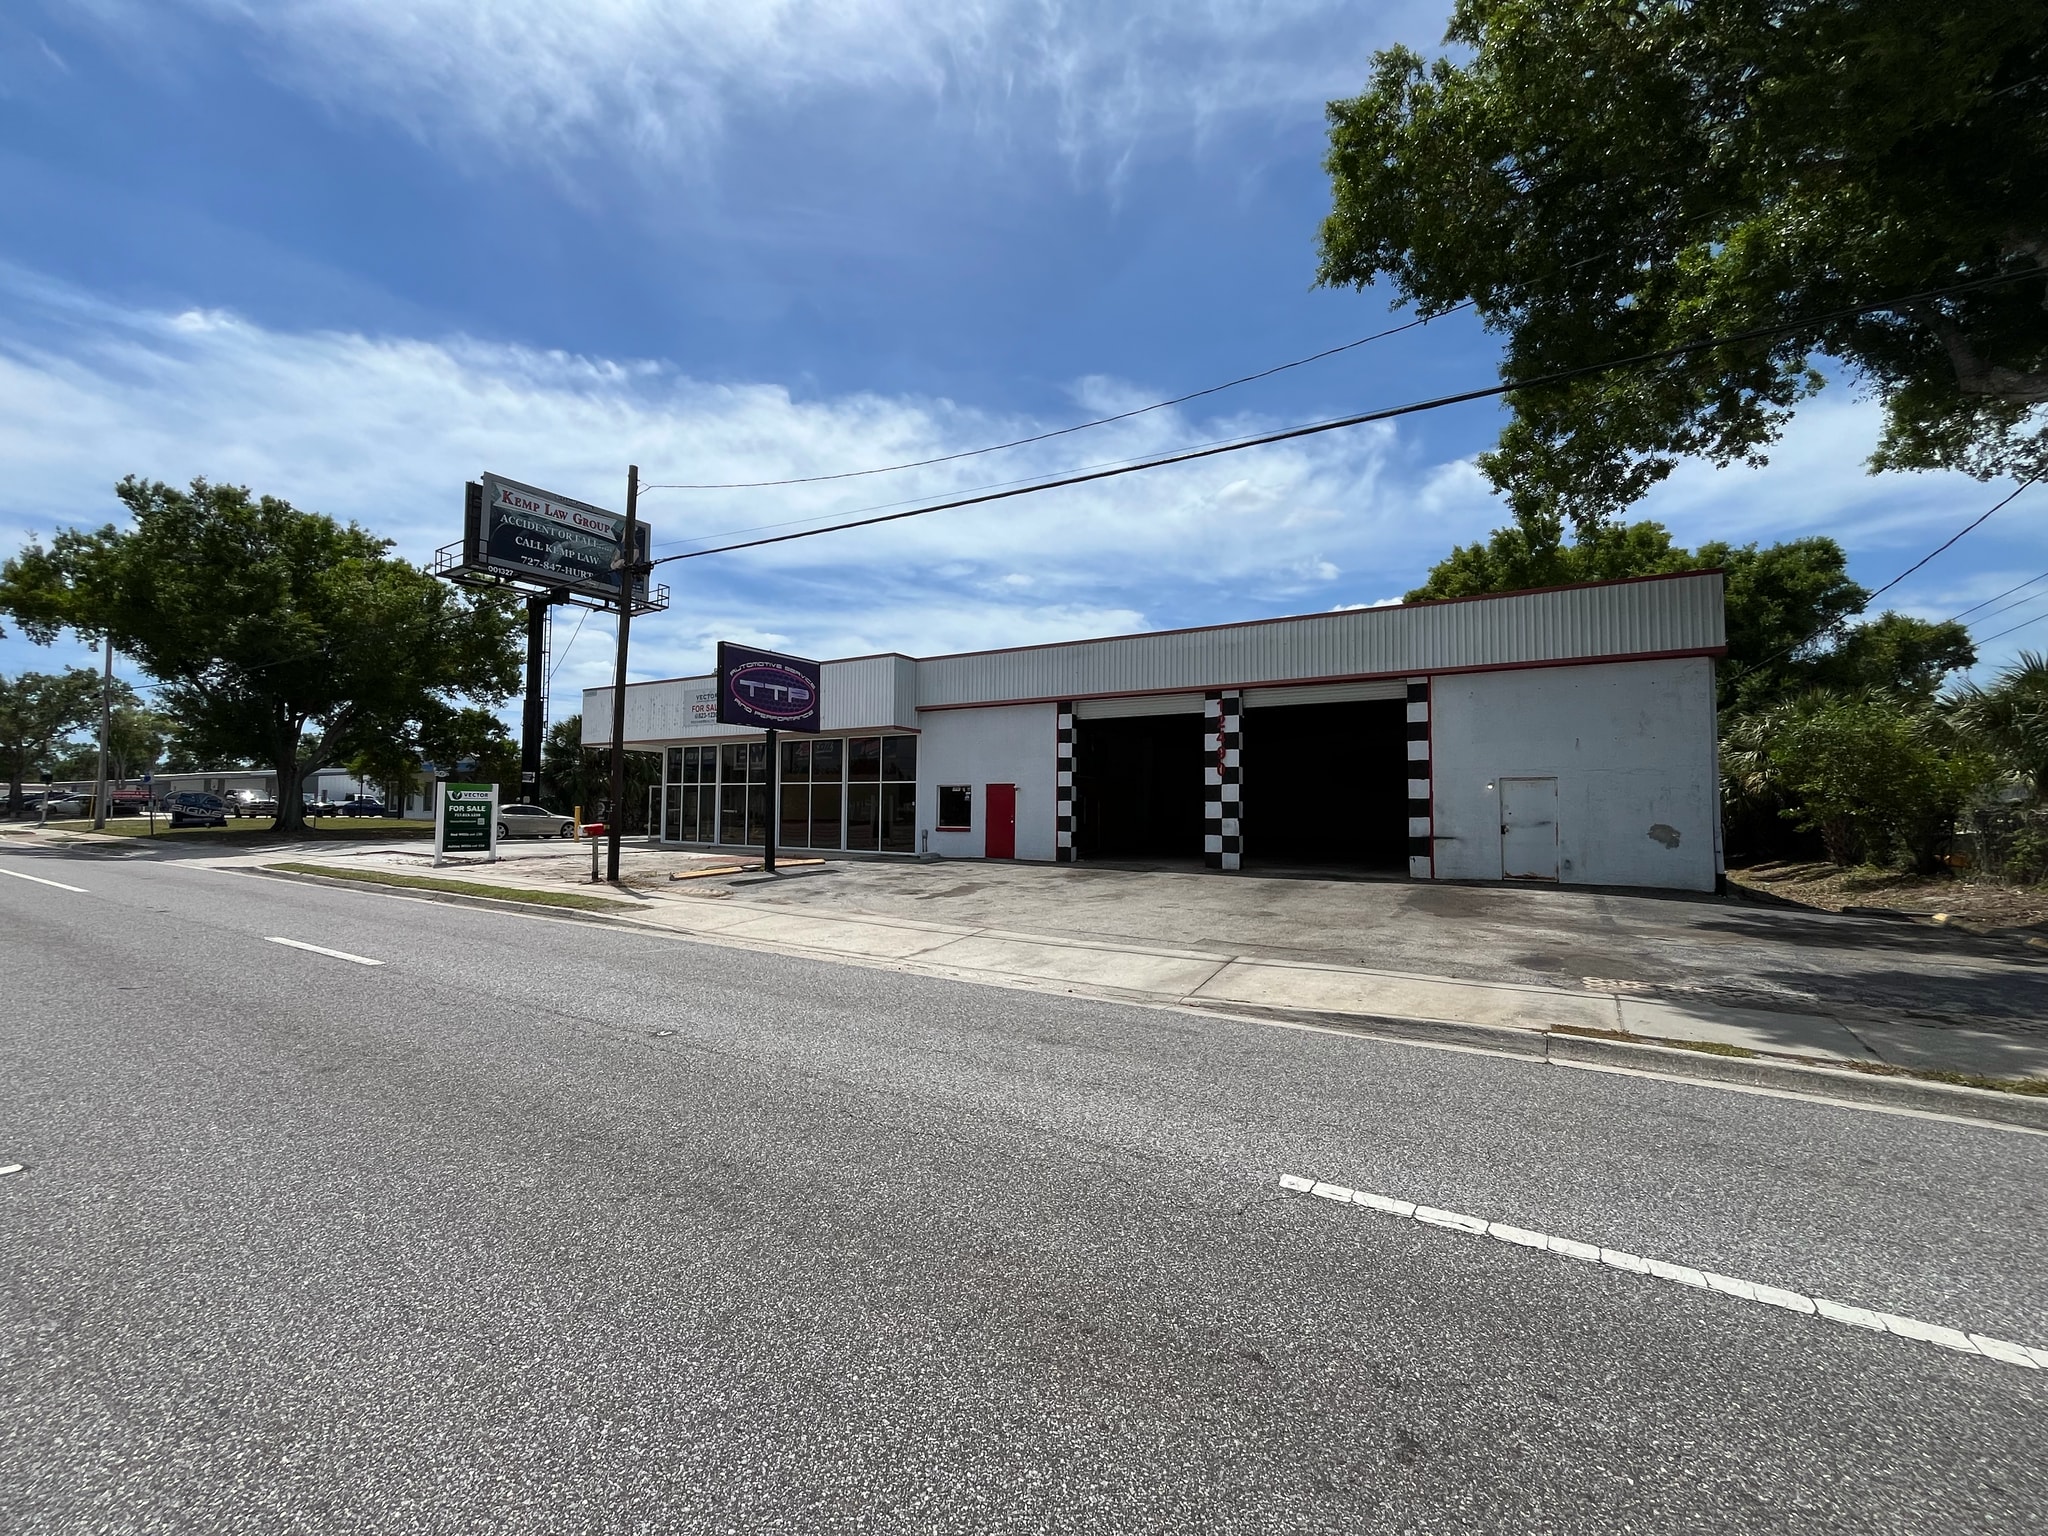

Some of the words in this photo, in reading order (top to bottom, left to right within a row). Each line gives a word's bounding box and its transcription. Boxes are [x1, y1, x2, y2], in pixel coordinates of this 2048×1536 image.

[544, 503, 568, 521] LAW
[500, 513, 555, 537] ACCIDENT
[557, 528, 573, 541] OR
[515, 536, 543, 551] CALL
[545, 543, 575, 560] KEMP
[577, 551, 600, 566] LAW
[487, 565, 514, 577] 001327
[729, 661, 783, 677] AUTOMOTIVE
[784, 665, 816, 690] SERVICE
[739, 679, 810, 703] TTP
[691, 705, 704, 713] FOR
[705, 703, 718, 712] SAL
[733, 697, 753, 714] AND
[754, 709, 814, 722] PERFORMANCE
[171, 804, 222, 818] SIGNS
